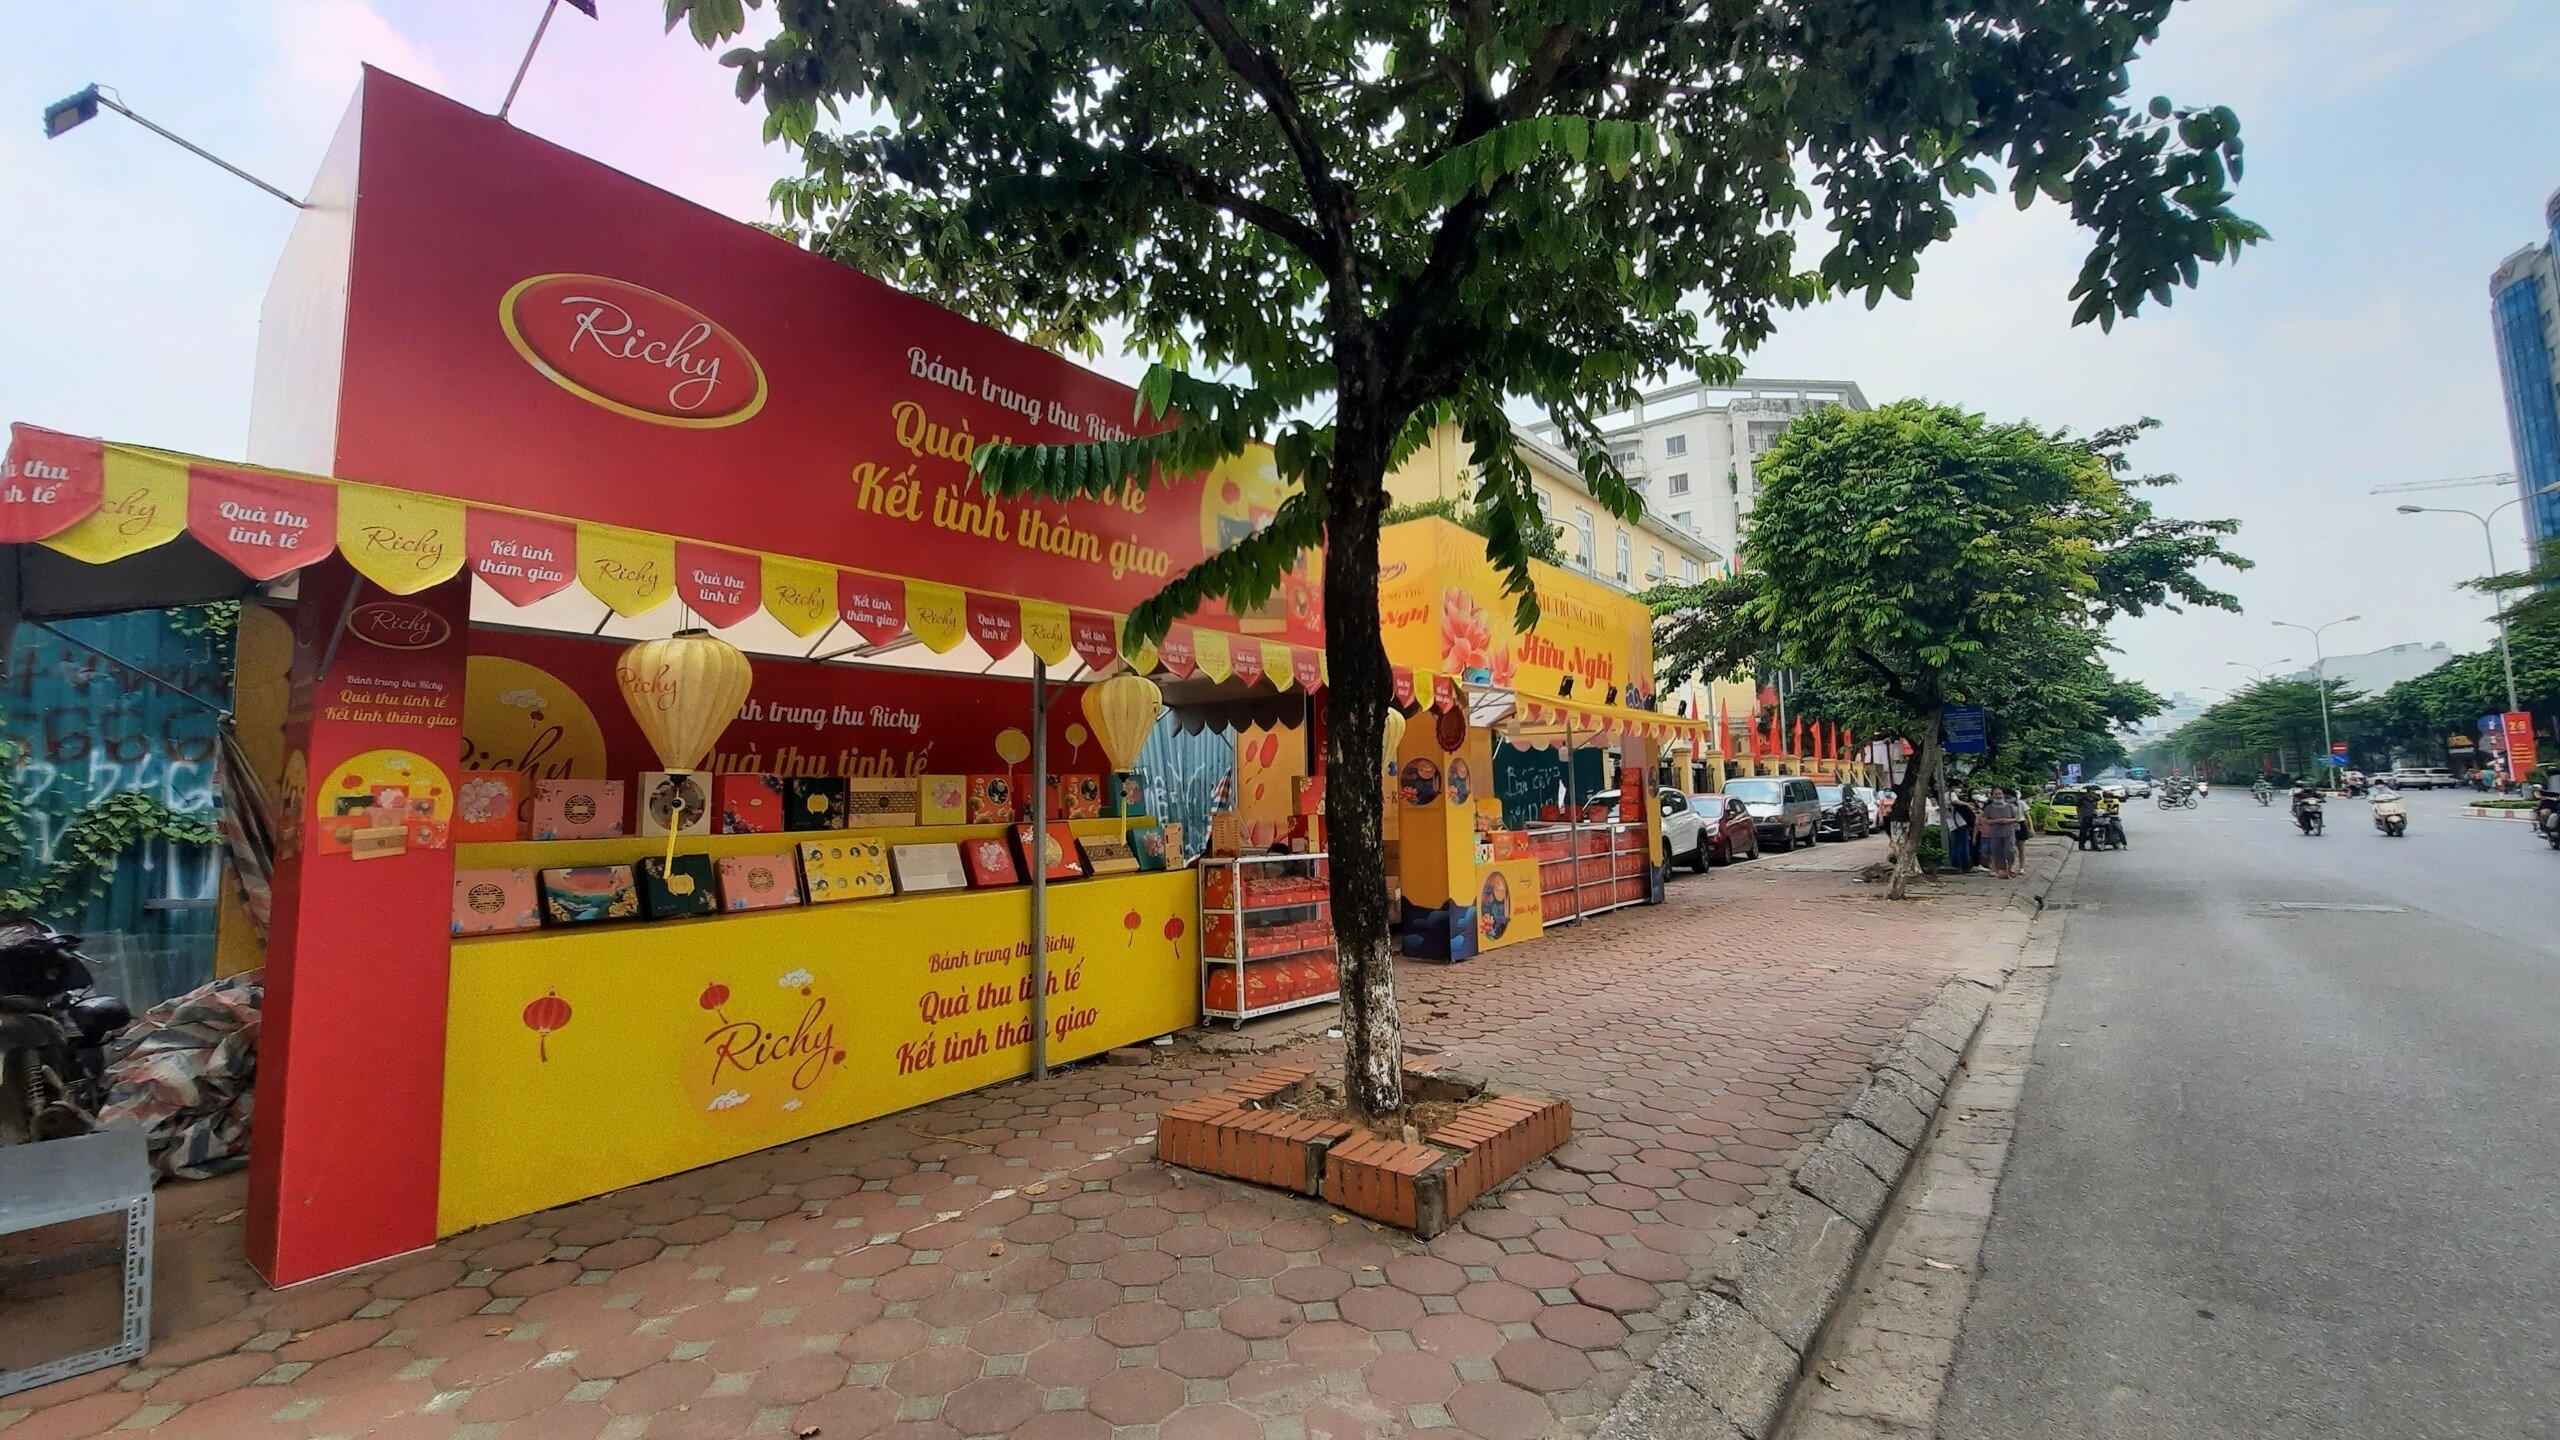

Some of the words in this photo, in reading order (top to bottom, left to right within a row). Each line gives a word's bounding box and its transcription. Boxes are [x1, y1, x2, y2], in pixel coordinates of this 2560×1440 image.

[561, 296, 722, 411] Richy
[907, 346, 976, 397] Bánh
[981, 377, 1042, 426] trung
[1047, 397, 1082, 433] thu
[891, 400, 973, 465] Quà
[23, 460, 70, 481] thu
[31, 482, 62, 504] tế
[101, 487, 157, 536] chy
[219, 501, 268, 524] Quà
[273, 509, 309, 529] thu
[852, 462, 923, 522] Kết
[932, 483, 1009, 542] tình
[1017, 509, 1103, 564] thâm
[1108, 533, 1174, 581] giao
[228, 526, 272, 547] tinh
[278, 530, 303, 550] tế
[361, 526, 444, 570] Richy
[490, 539, 517, 556] Kết
[520, 543, 555, 563] tình
[478, 558, 525, 578] thâm
[527, 567, 564, 584] giao
[594, 558, 659, 597] Richy
[692, 569, 721, 586] Quà
[723, 575, 746, 590] thu
[699, 587, 728, 603] tinh
[729, 589, 743, 605] tế
[775, 585, 825, 618] Richy
[852, 593, 870, 608] Kết
[368, 610, 432, 644] Richy
[847, 610, 874, 624] thâm
[876, 615, 900, 628] giao
[917, 606, 957, 637] Richy
[977, 612, 995, 626] Quà
[997, 617, 1011, 628] thu
[1554, 598, 1586, 623] TRUNG
[1590, 612, 1606, 630] THU
[1030, 622, 1063, 650] Richy
[1517, 633, 1564, 671] Hữu
[1568, 646, 1612, 691] Nghị
[340, 689, 372, 704] Quà
[376, 693, 399, 706] thu
[402, 695, 430, 708] tinh
[434, 694, 450, 708] tế
[346, 675, 372, 685] Bánh
[374, 678, 400, 688] trung
[402, 680, 417, 689] thu
[419, 681, 443, 692] Richy
[325, 706, 350, 721] Kết
[386, 711, 423, 725] thâm
[426, 714, 457, 728] giao
[734, 699, 763, 721] nh
[769, 701, 828, 731] trung
[832, 704, 865, 726] thu
[869, 705, 921, 734] Richy
[773, 746, 830, 777] thu
[839, 747, 897, 778] tinh
[905, 741, 934, 777] tế
[929, 951, 969, 973] Bánh
[973, 947, 1012, 966] trung
[919, 986, 971, 1025] Quà
[976, 982, 1013, 1011] thu
[1019, 970, 1059, 1001] tih
[1065, 957, 1085, 992] tế
[703, 997, 835, 1091] Richy
[896, 1031, 936, 1075] Kết
[943, 1028, 989, 1064] tình
[1055, 1006, 1099, 1043] giao
